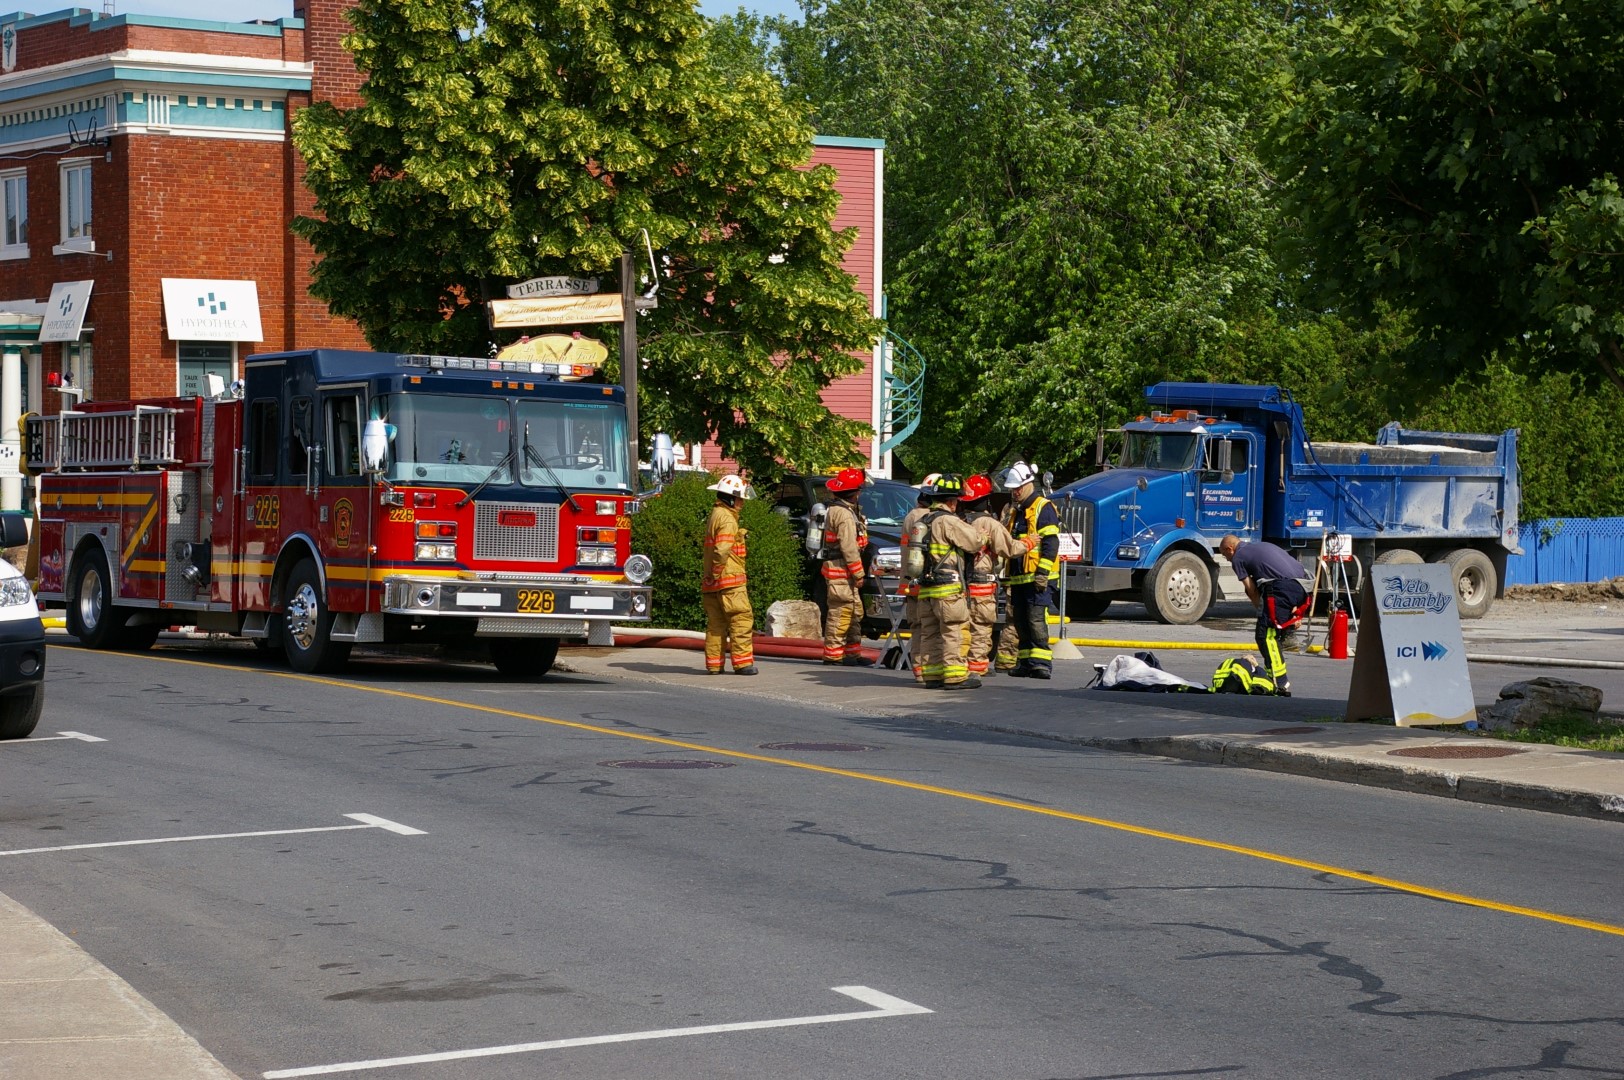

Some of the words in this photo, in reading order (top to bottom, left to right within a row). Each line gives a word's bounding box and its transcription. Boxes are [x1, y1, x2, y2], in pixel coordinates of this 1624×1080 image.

[516, 279, 591, 296] TERRASSE
[181, 318, 247, 328] HYPOTHECA
[1202, 488, 1233, 496] EXCAVATION
[255, 494, 280, 529] 226
[389, 508, 415, 523] 226
[1382, 576, 1430, 595] Vélo
[517, 589, 555, 614] 226
[1382, 592, 1453, 615] Chambly
[1397, 646, 1417, 658] ICI
